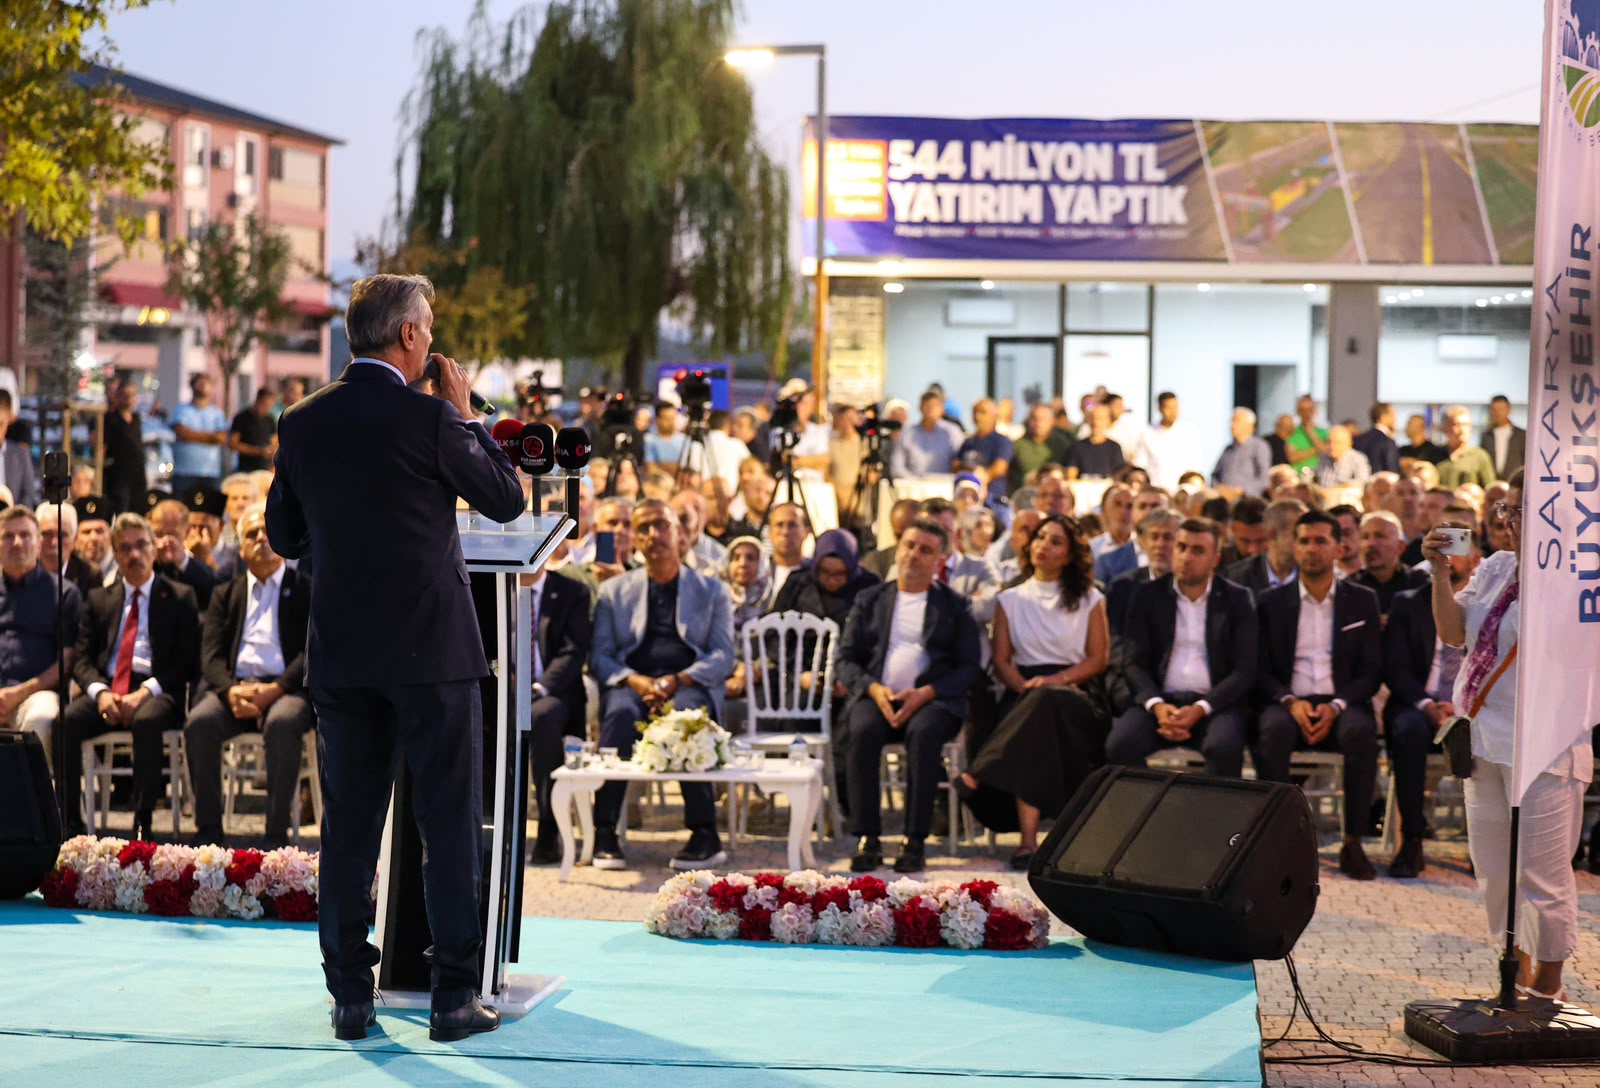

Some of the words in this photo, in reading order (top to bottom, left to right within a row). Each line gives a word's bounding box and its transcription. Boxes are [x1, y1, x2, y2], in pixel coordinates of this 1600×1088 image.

[887, 182, 1043, 223] YATIRIM
[1048, 185, 1188, 224] YAPTIK
[888, 139, 966, 180] 544
[971, 134, 1113, 181] MİLYON
[1119, 143, 1166, 182] TL
[1538, 272, 1562, 570] SAKARYA
[1566, 223, 1600, 623] BÜYÜKŞEHİR
